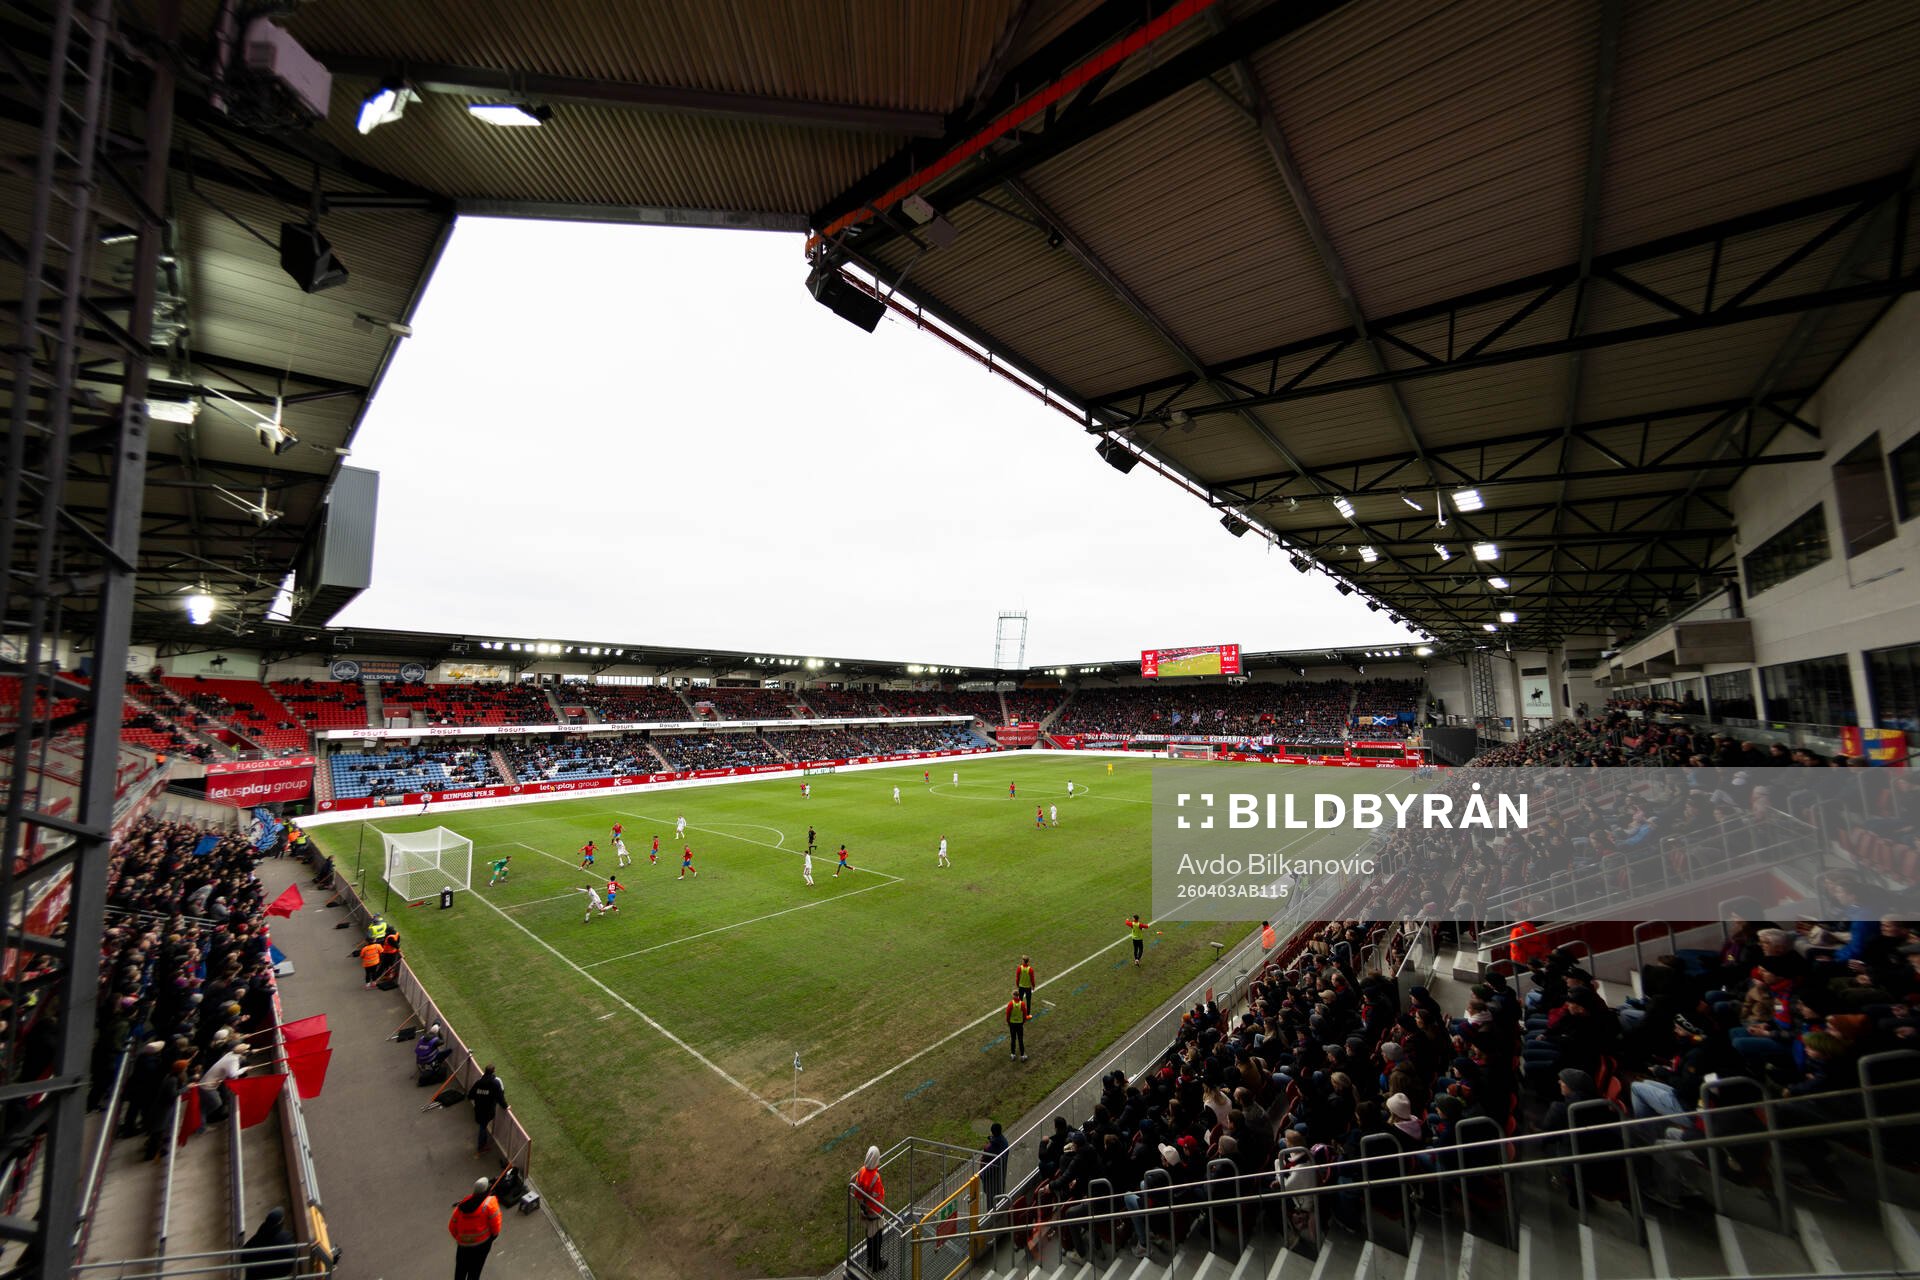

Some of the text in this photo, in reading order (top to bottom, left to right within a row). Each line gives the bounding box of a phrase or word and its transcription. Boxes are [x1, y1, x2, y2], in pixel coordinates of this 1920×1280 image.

[236, 759, 292, 769] FLAGGA.COM
[210, 779, 308, 799] letusplay group
[539, 780, 600, 791] letplay group
